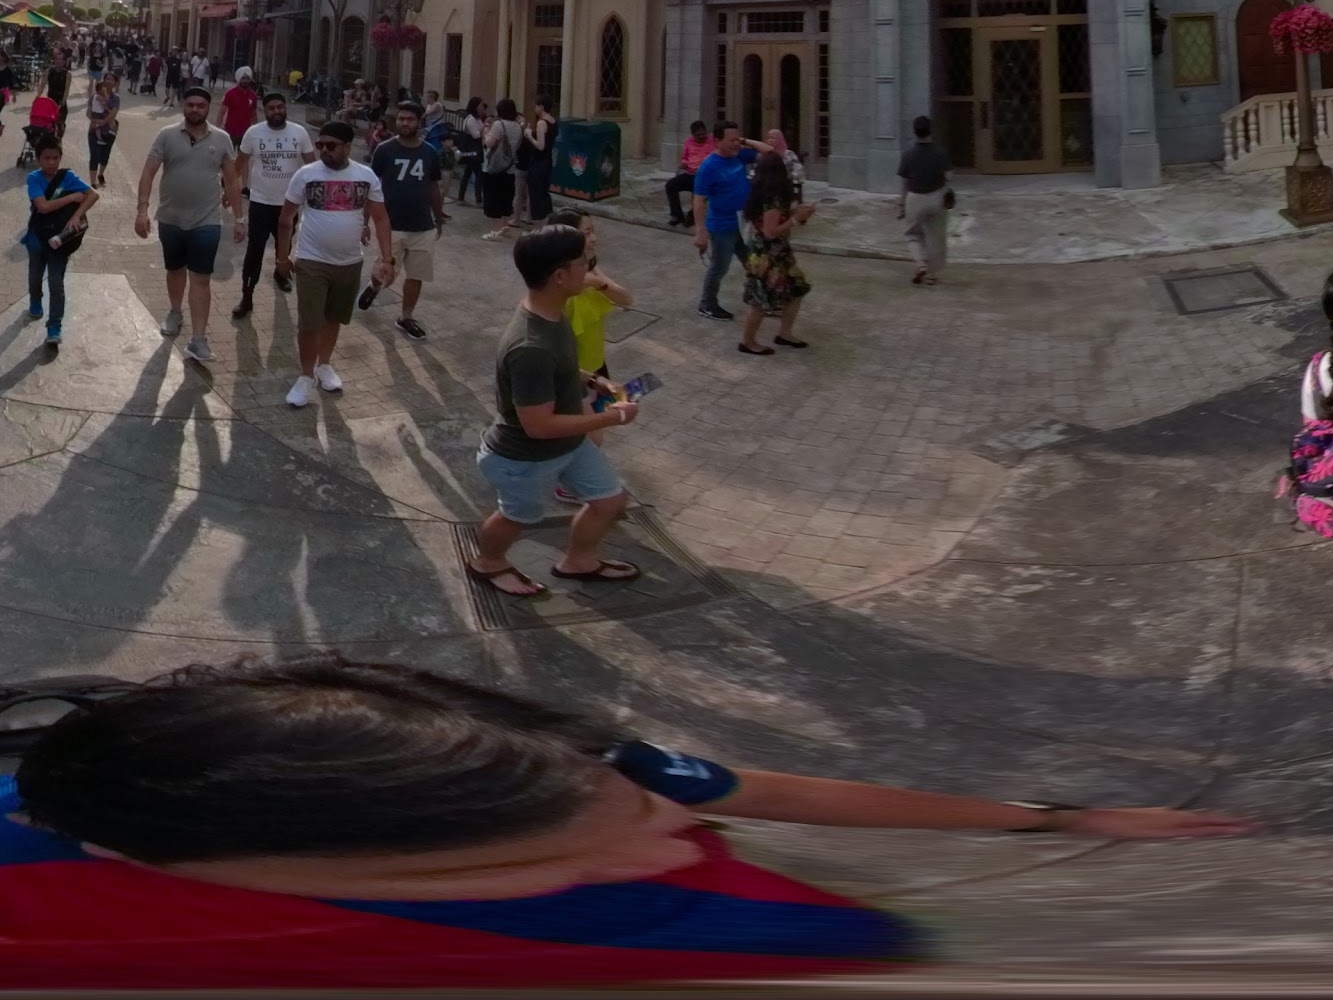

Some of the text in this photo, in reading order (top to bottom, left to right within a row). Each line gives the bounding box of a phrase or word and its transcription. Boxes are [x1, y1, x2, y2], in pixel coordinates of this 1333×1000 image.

[259, 142, 299, 151] DRY
[260, 152, 298, 160] SURPLUS
[394, 158, 425, 181] 74
